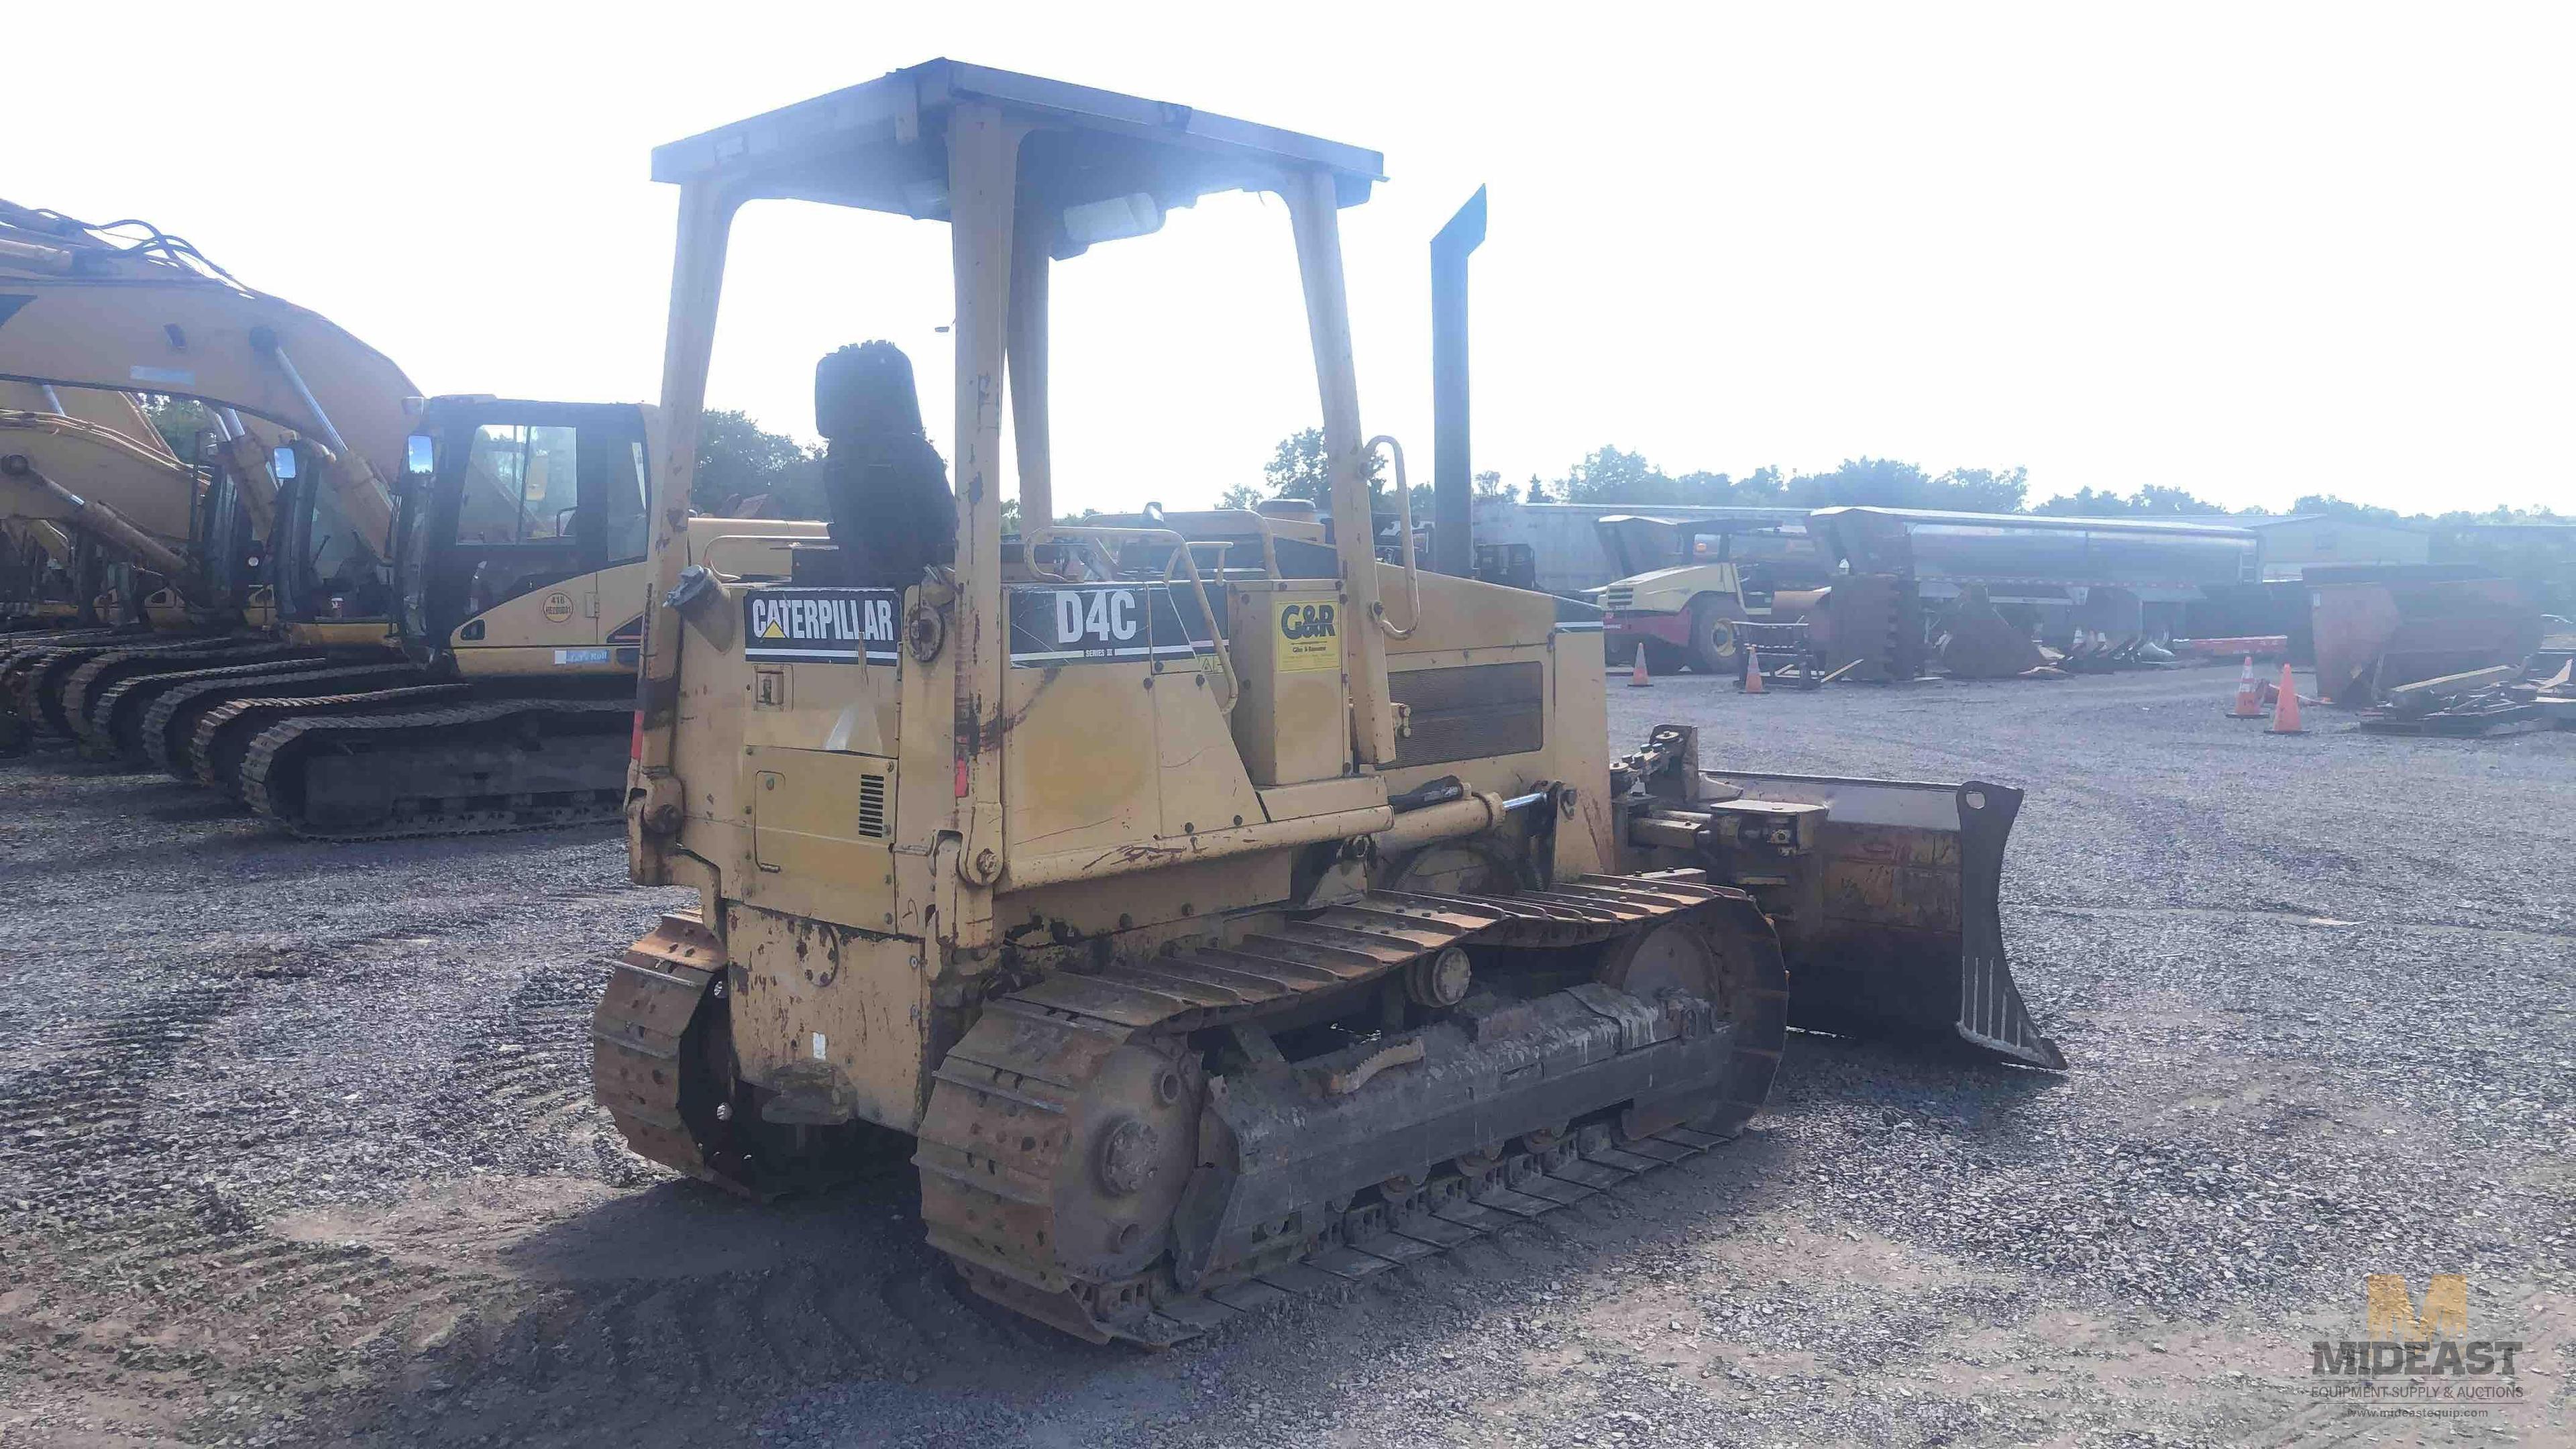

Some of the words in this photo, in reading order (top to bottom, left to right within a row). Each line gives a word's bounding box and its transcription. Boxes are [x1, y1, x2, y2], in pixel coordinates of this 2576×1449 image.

[752, 599, 894, 641] CATERPILLAR
[1056, 590, 1137, 643] D4C
[1281, 604, 1336, 639] G&R
[1085, 649, 1105, 657] SERIES
